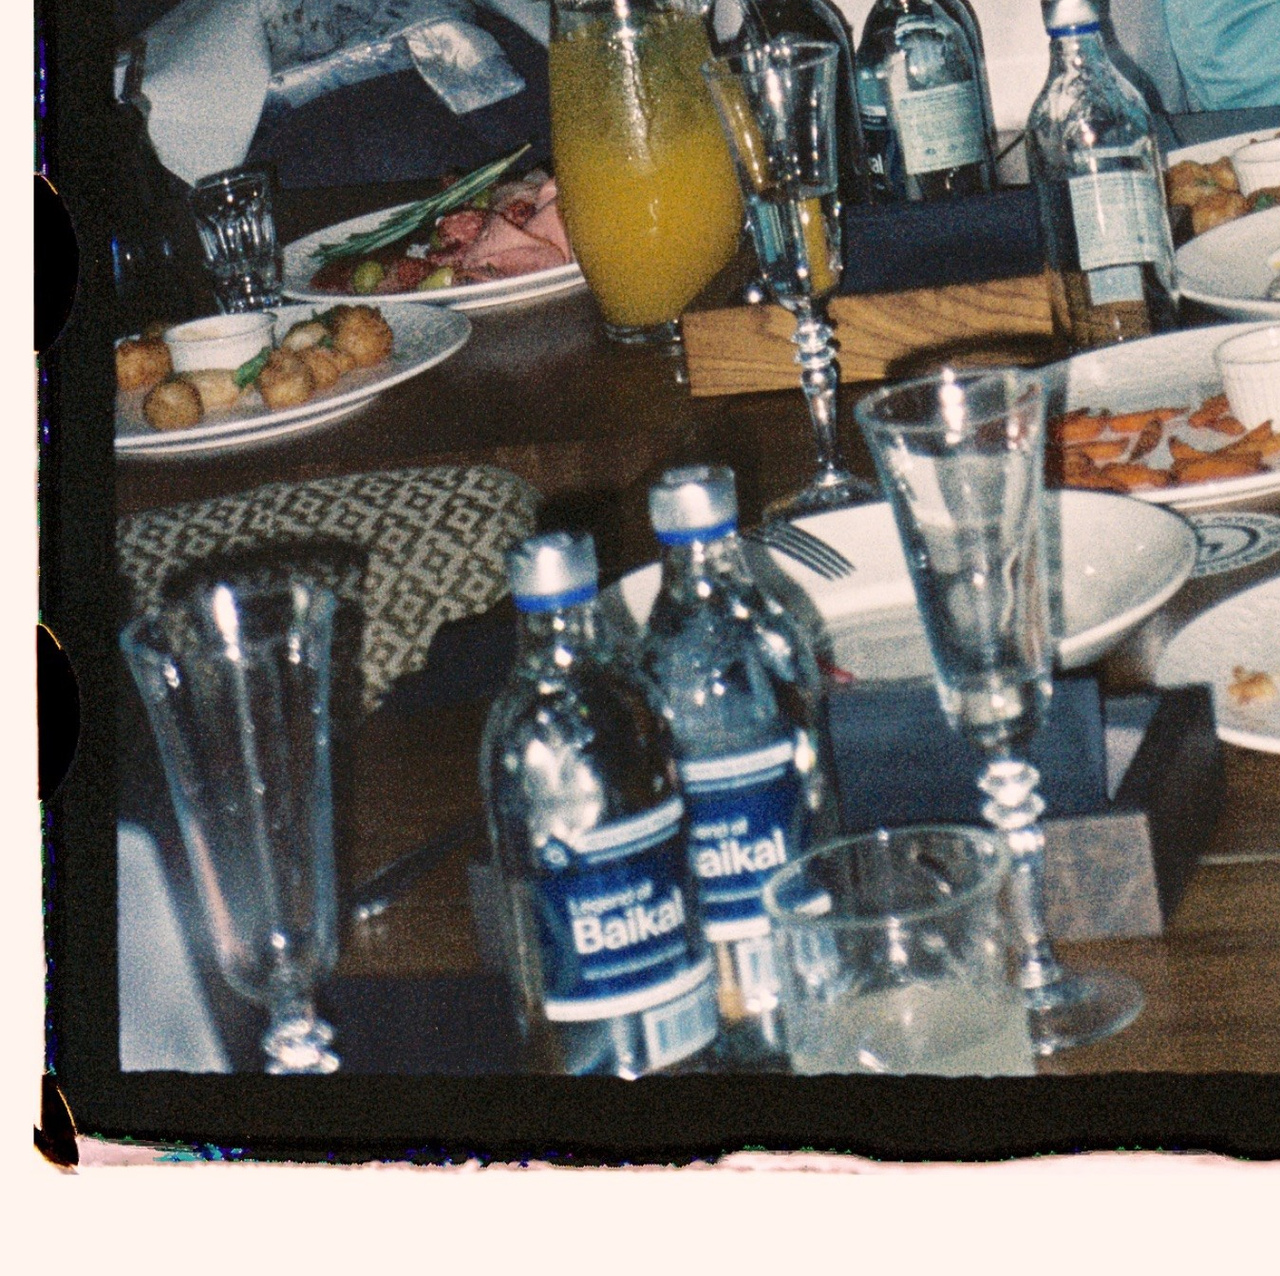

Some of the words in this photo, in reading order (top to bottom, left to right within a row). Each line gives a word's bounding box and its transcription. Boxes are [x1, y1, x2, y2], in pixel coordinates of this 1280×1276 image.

[695, 827, 788, 879] aikal
[568, 888, 636, 917] Legend
[635, 879, 654, 902] of
[572, 885, 685, 956] Baikal
